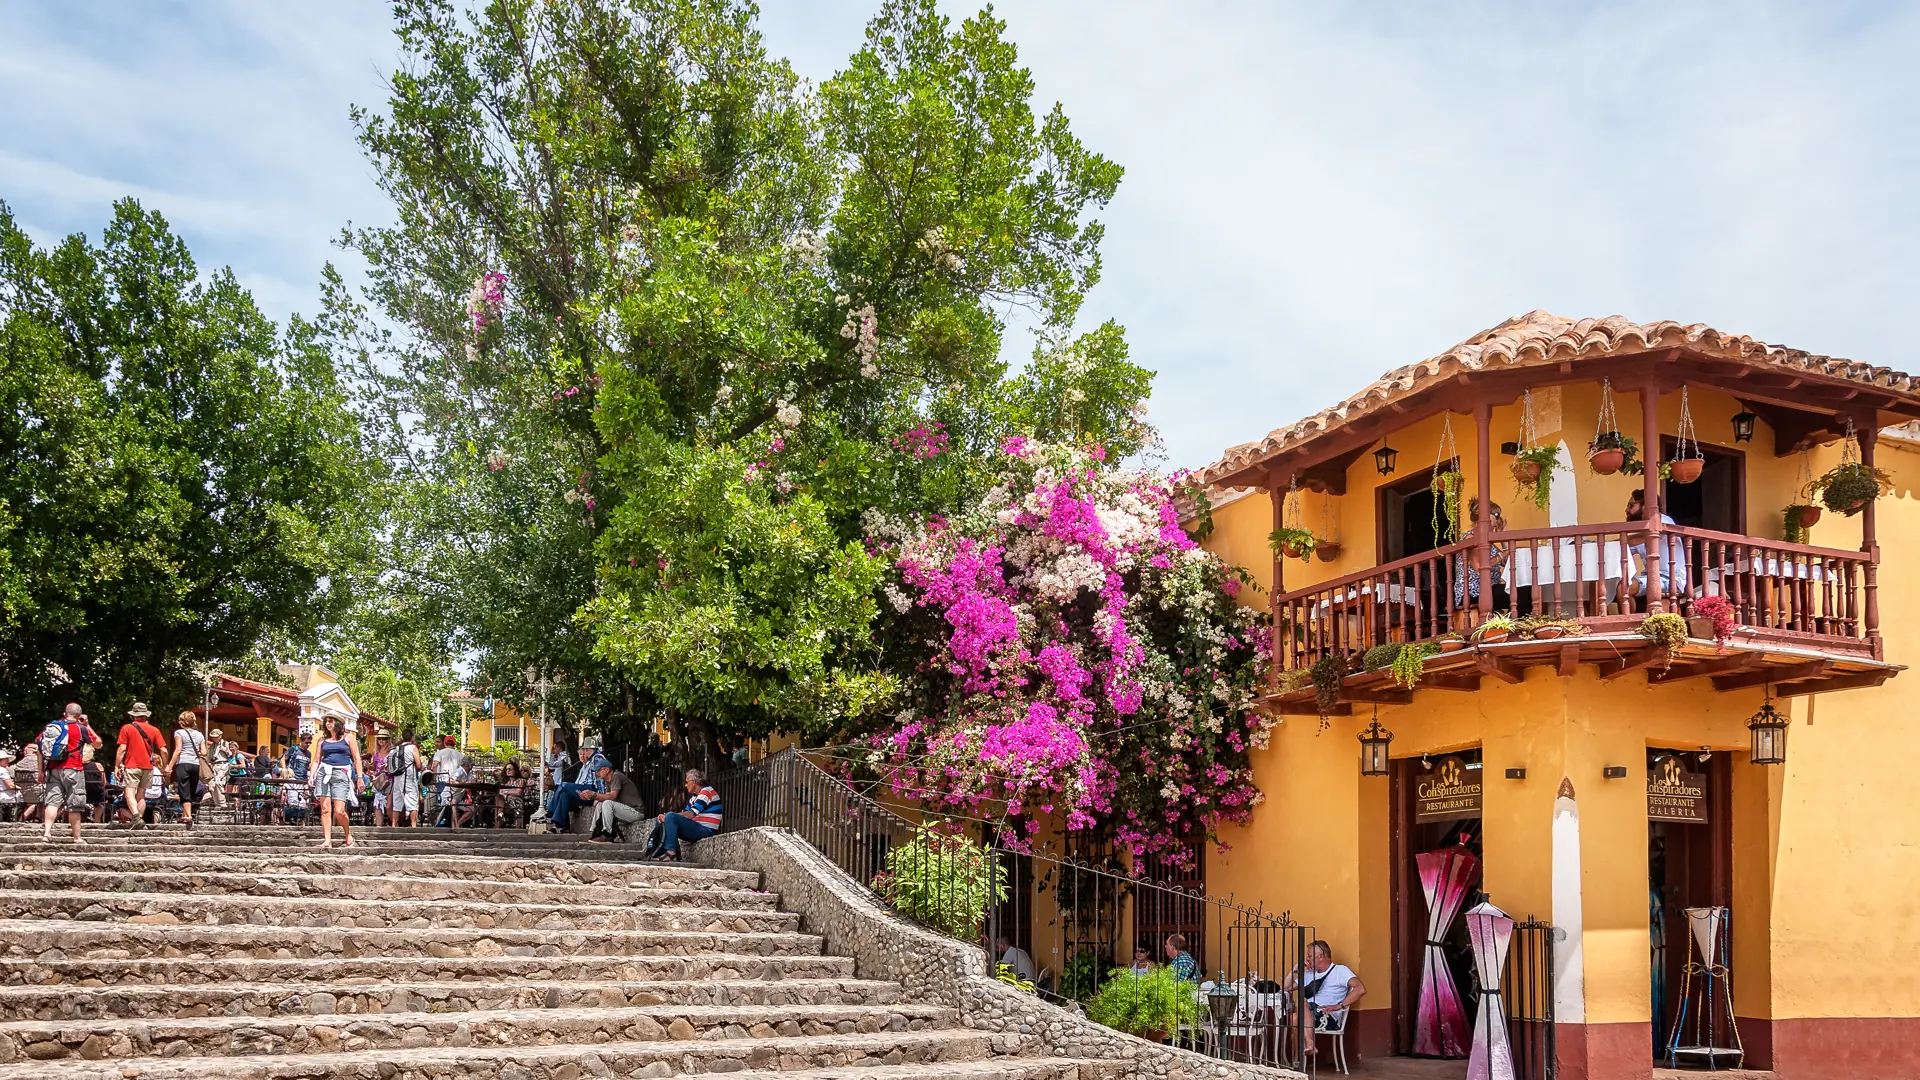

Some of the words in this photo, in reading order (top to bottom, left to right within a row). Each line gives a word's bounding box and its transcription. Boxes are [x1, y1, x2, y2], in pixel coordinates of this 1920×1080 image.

[1432, 780, 1445, 789] Los
[1653, 775, 1667, 785] Los
[1418, 780, 1481, 798] Conspiradores
[1426, 798, 1474, 811] RESTAURANTE
[1649, 797, 1695, 807] RESTAURANTE
[1649, 806, 1695, 817] GALERIA
